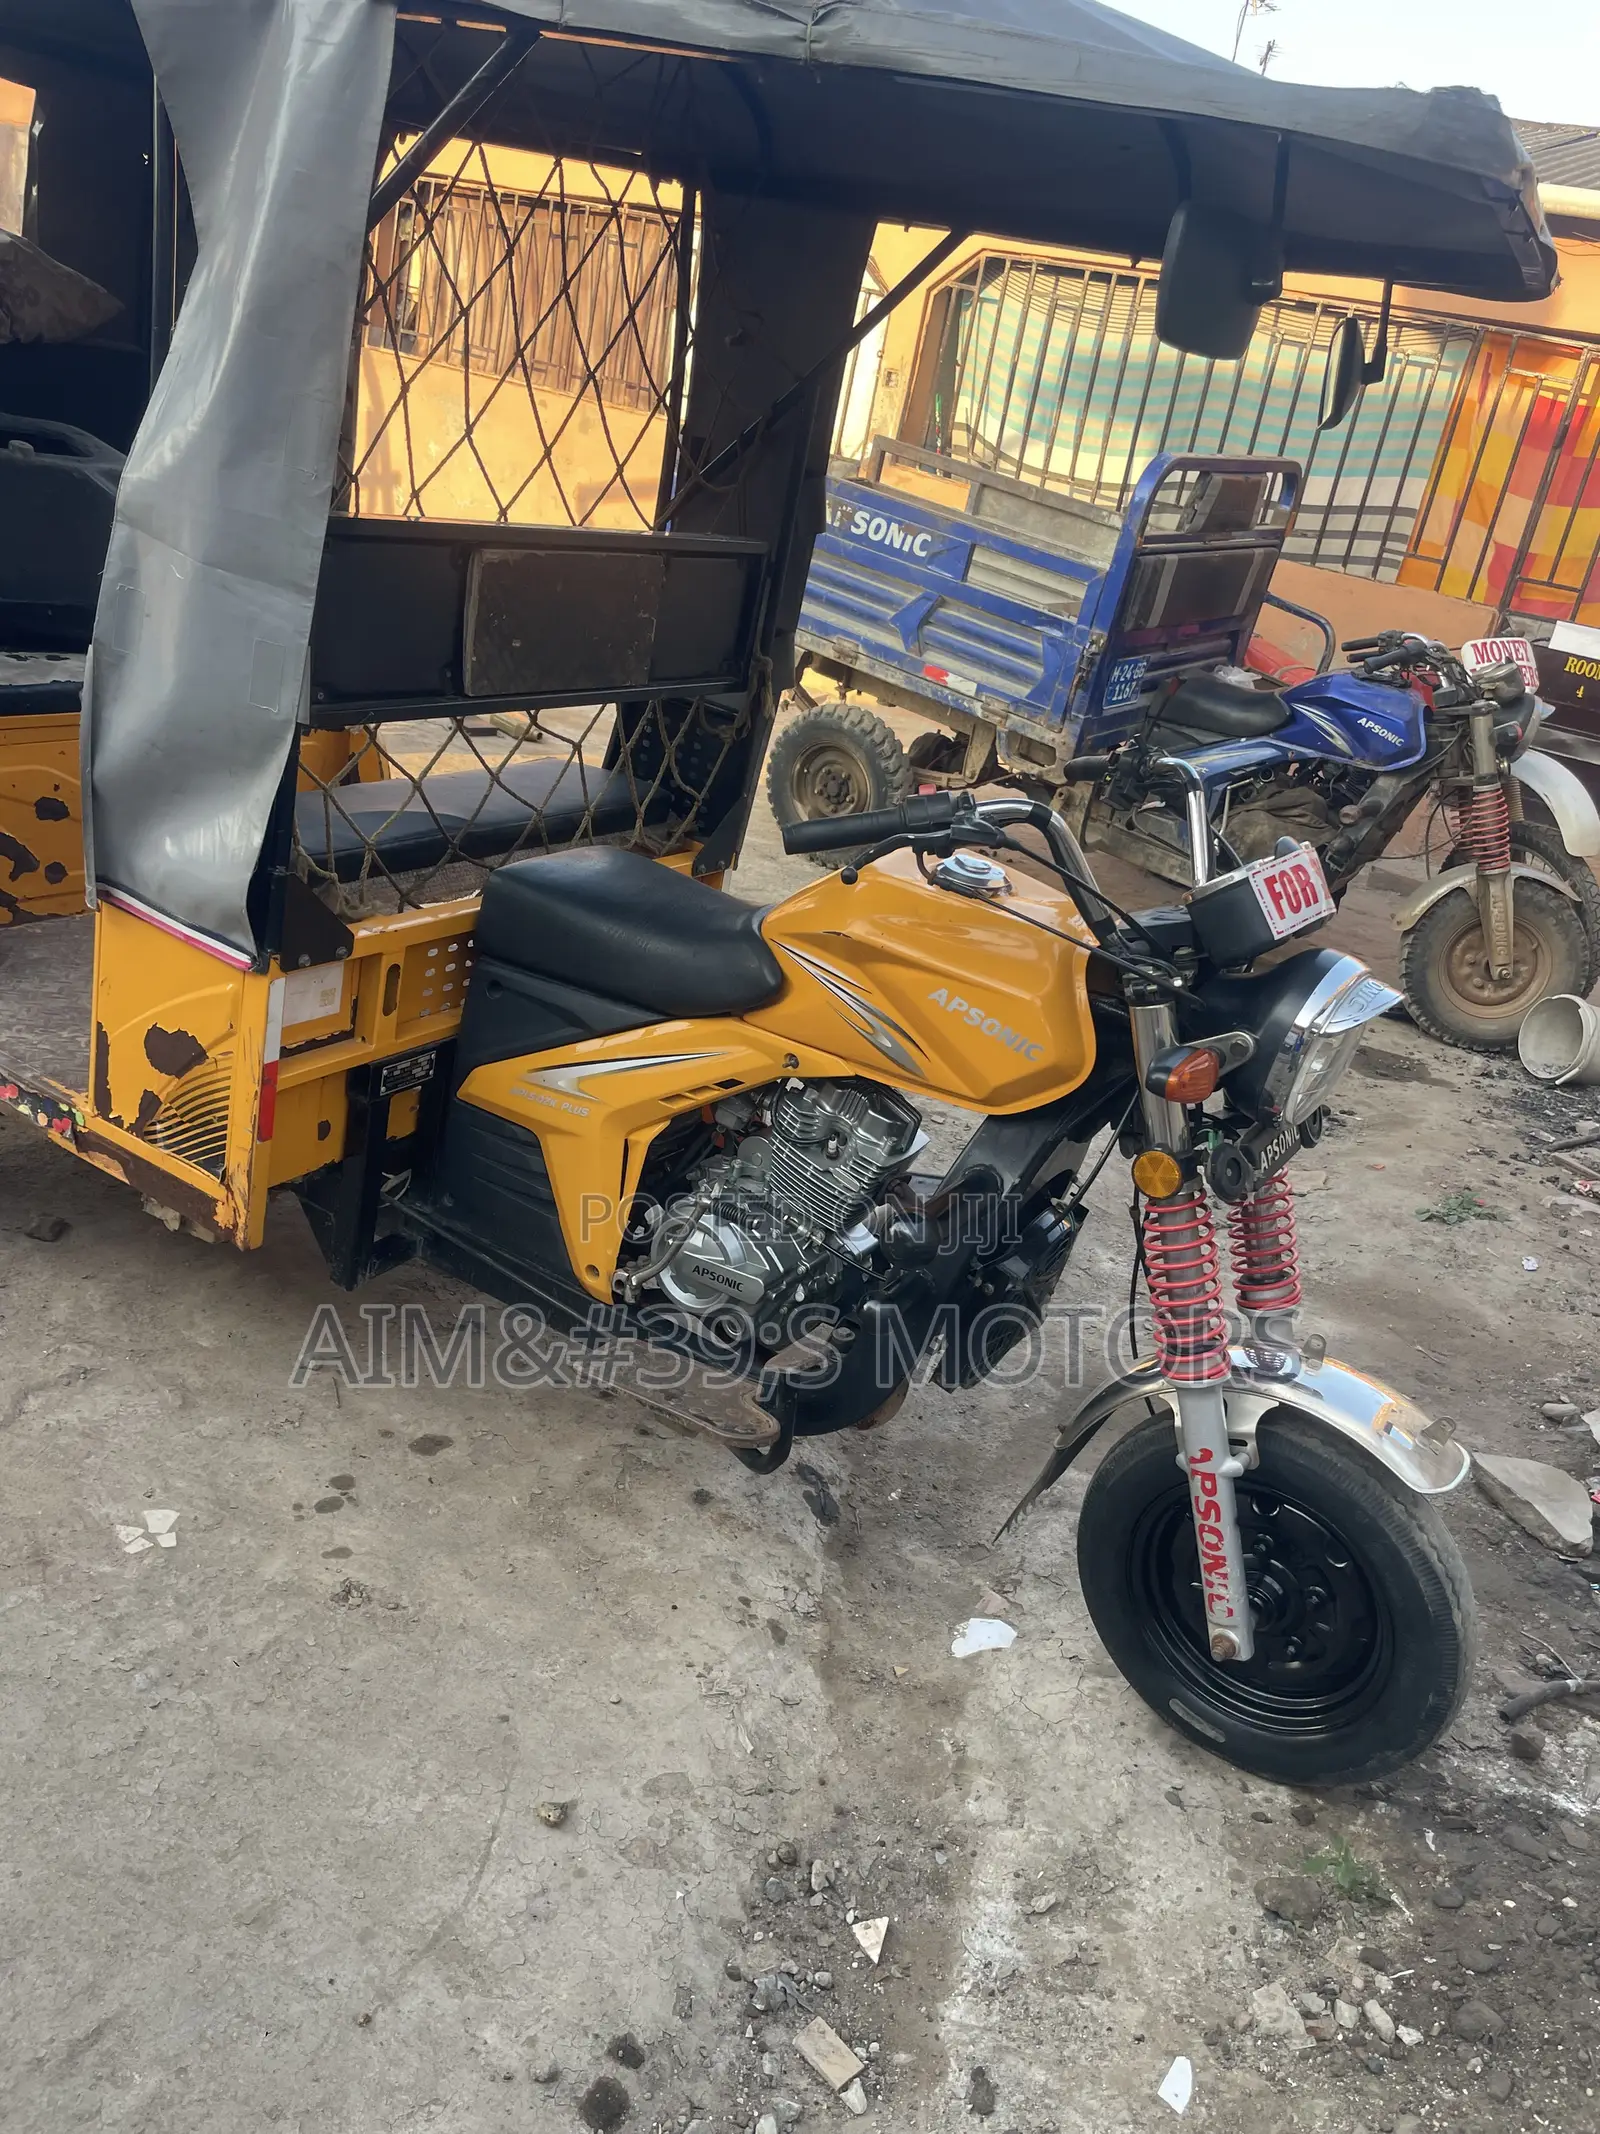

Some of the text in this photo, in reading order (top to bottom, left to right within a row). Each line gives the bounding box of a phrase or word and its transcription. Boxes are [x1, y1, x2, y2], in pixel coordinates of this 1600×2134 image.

[826, 500, 932, 557] SONIC
[1471, 640, 1530, 665] MONEY
[1112, 681, 1137, 701] 1167
[1576, 686, 1585, 698] 4
[1357, 717, 1404, 747] APSONIC
[1263, 864, 1319, 920] FOR
[928, 988, 1044, 1061] APSONIC
[561, 1102, 590, 1117] PLUS
[1261, 1125, 1300, 1173] APSONIC
[692, 1265, 744, 1292] APSONIC
